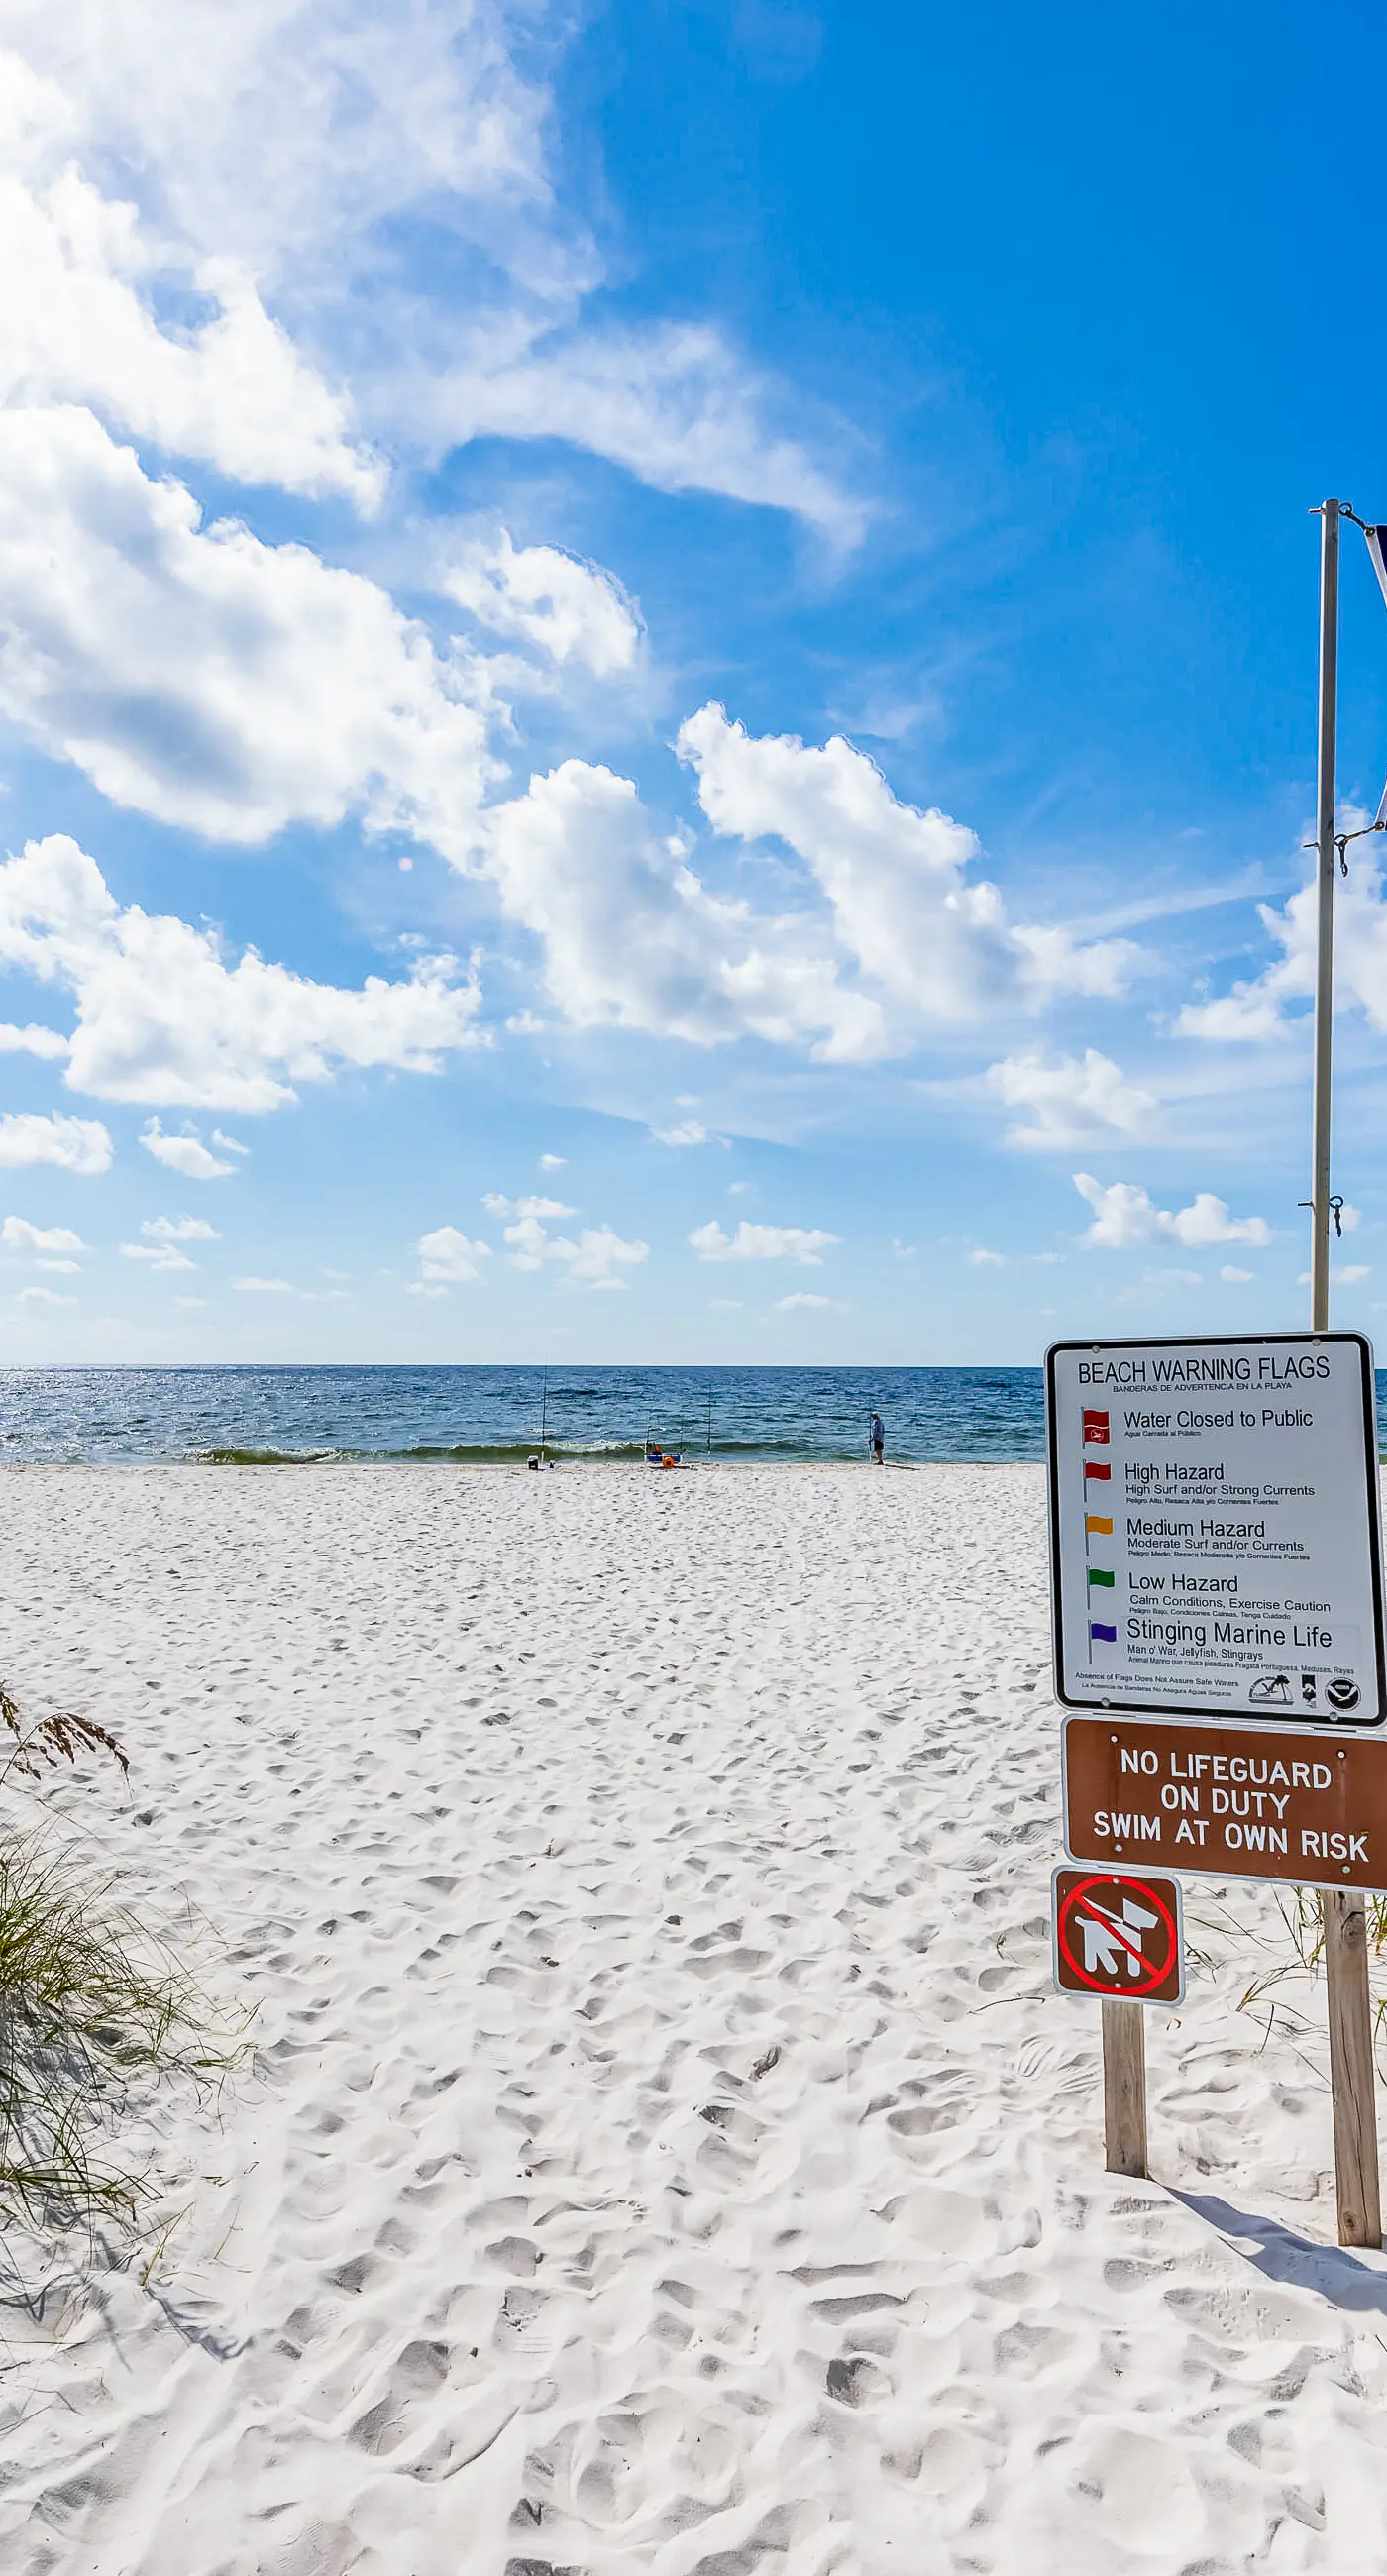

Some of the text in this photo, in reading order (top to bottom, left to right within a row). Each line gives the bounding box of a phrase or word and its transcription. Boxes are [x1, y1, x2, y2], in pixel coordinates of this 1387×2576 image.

[1079, 1356, 1330, 1383] BEACH WARNING FLAGS
[1124, 1409, 1314, 1428] Water Closed to Public
[1125, 1462, 1224, 1484] High Hazard
[1126, 1484, 1315, 1497] High Surf and/or Strong Currents
[1126, 1518, 1265, 1537] Medium Hazard
[1128, 1538, 1304, 1551] Moderate Surf and/or Currents
[1129, 1572, 1238, 1592] Low Hazard
[1130, 1595, 1331, 1611] Calm Conditions, Exercise Caution
[1127, 1618, 1333, 1648] Stinging Marine Life
[1128, 1645, 1147, 1654] Man
[1158, 1646, 1178, 1656] War,
[1180, 1647, 1219, 1658] Jellyfish,
[1221, 1649, 1263, 1662] Stingrays
[1115, 1674, 1133, 1683] Flags
[1120, 1749, 1332, 1789] NO LIFEGUARD
[1161, 1783, 1290, 1820] ON DUTY
[1093, 1811, 1370, 1862] SWIM AT OWN RISK
